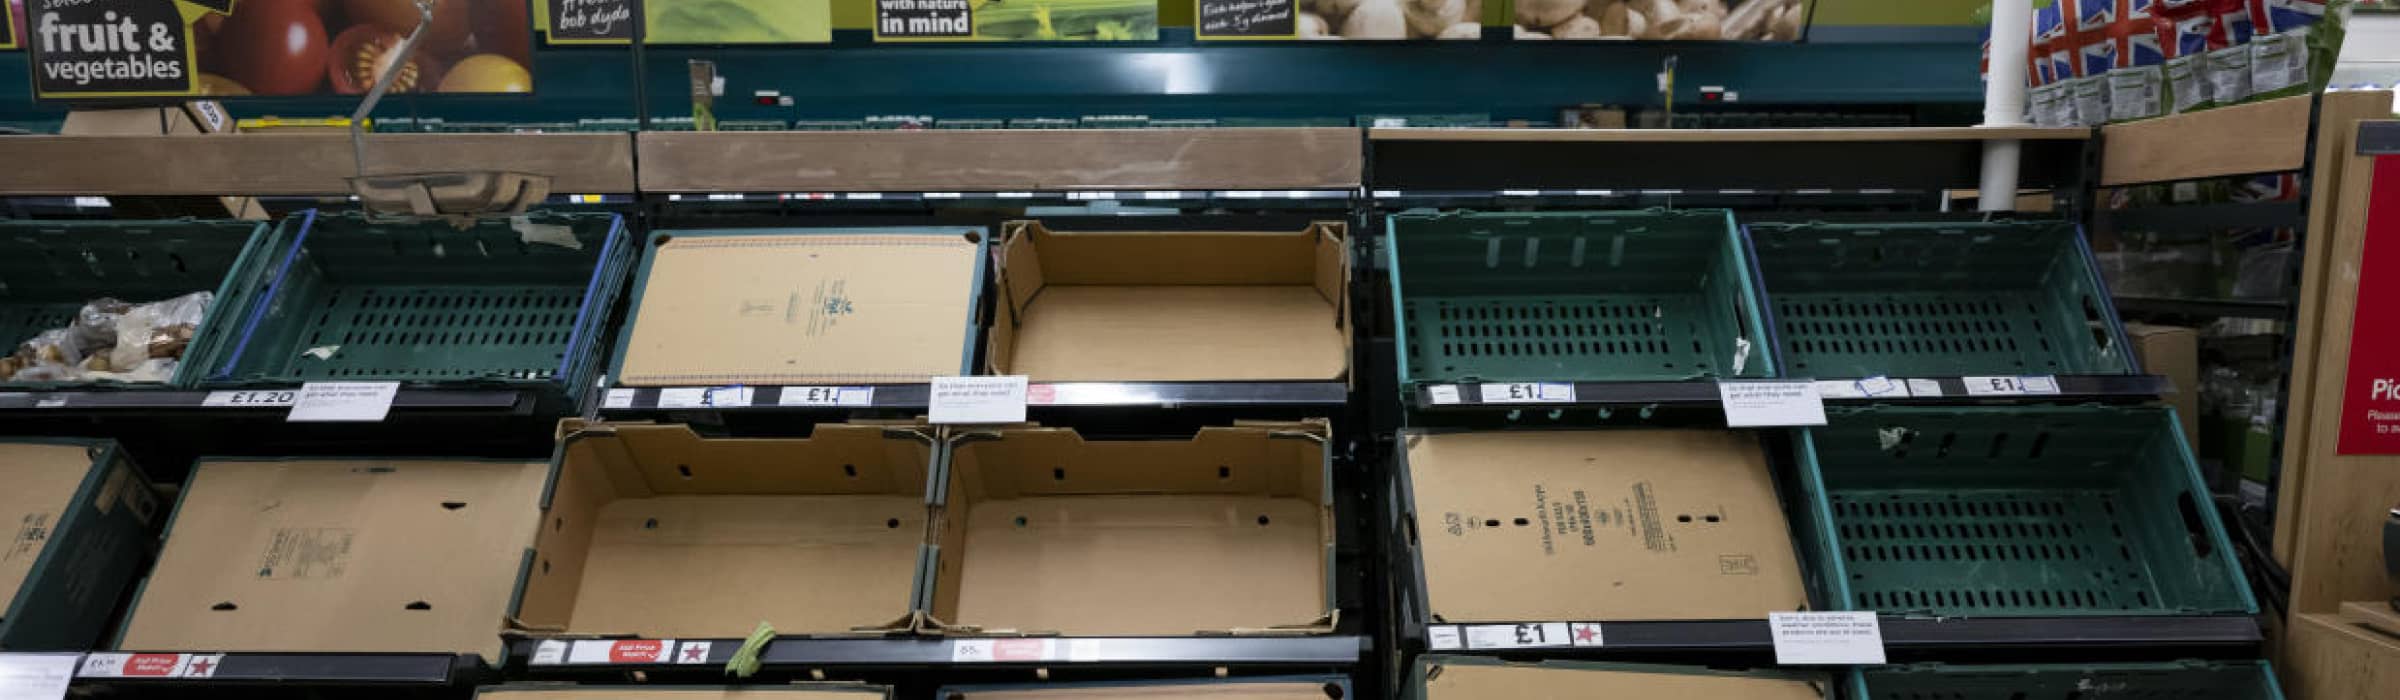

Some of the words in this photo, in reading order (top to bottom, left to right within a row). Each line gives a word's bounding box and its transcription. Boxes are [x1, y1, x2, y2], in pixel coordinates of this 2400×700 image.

[39, 10, 141, 52] fruit
[149, 22, 175, 51] &
[881, 12, 904, 33] in
[908, 11, 969, 33] mind
[43, 54, 182, 85] vegetables
[231, 391, 295, 403] £1.20
[1514, 623, 1546, 644] £1
